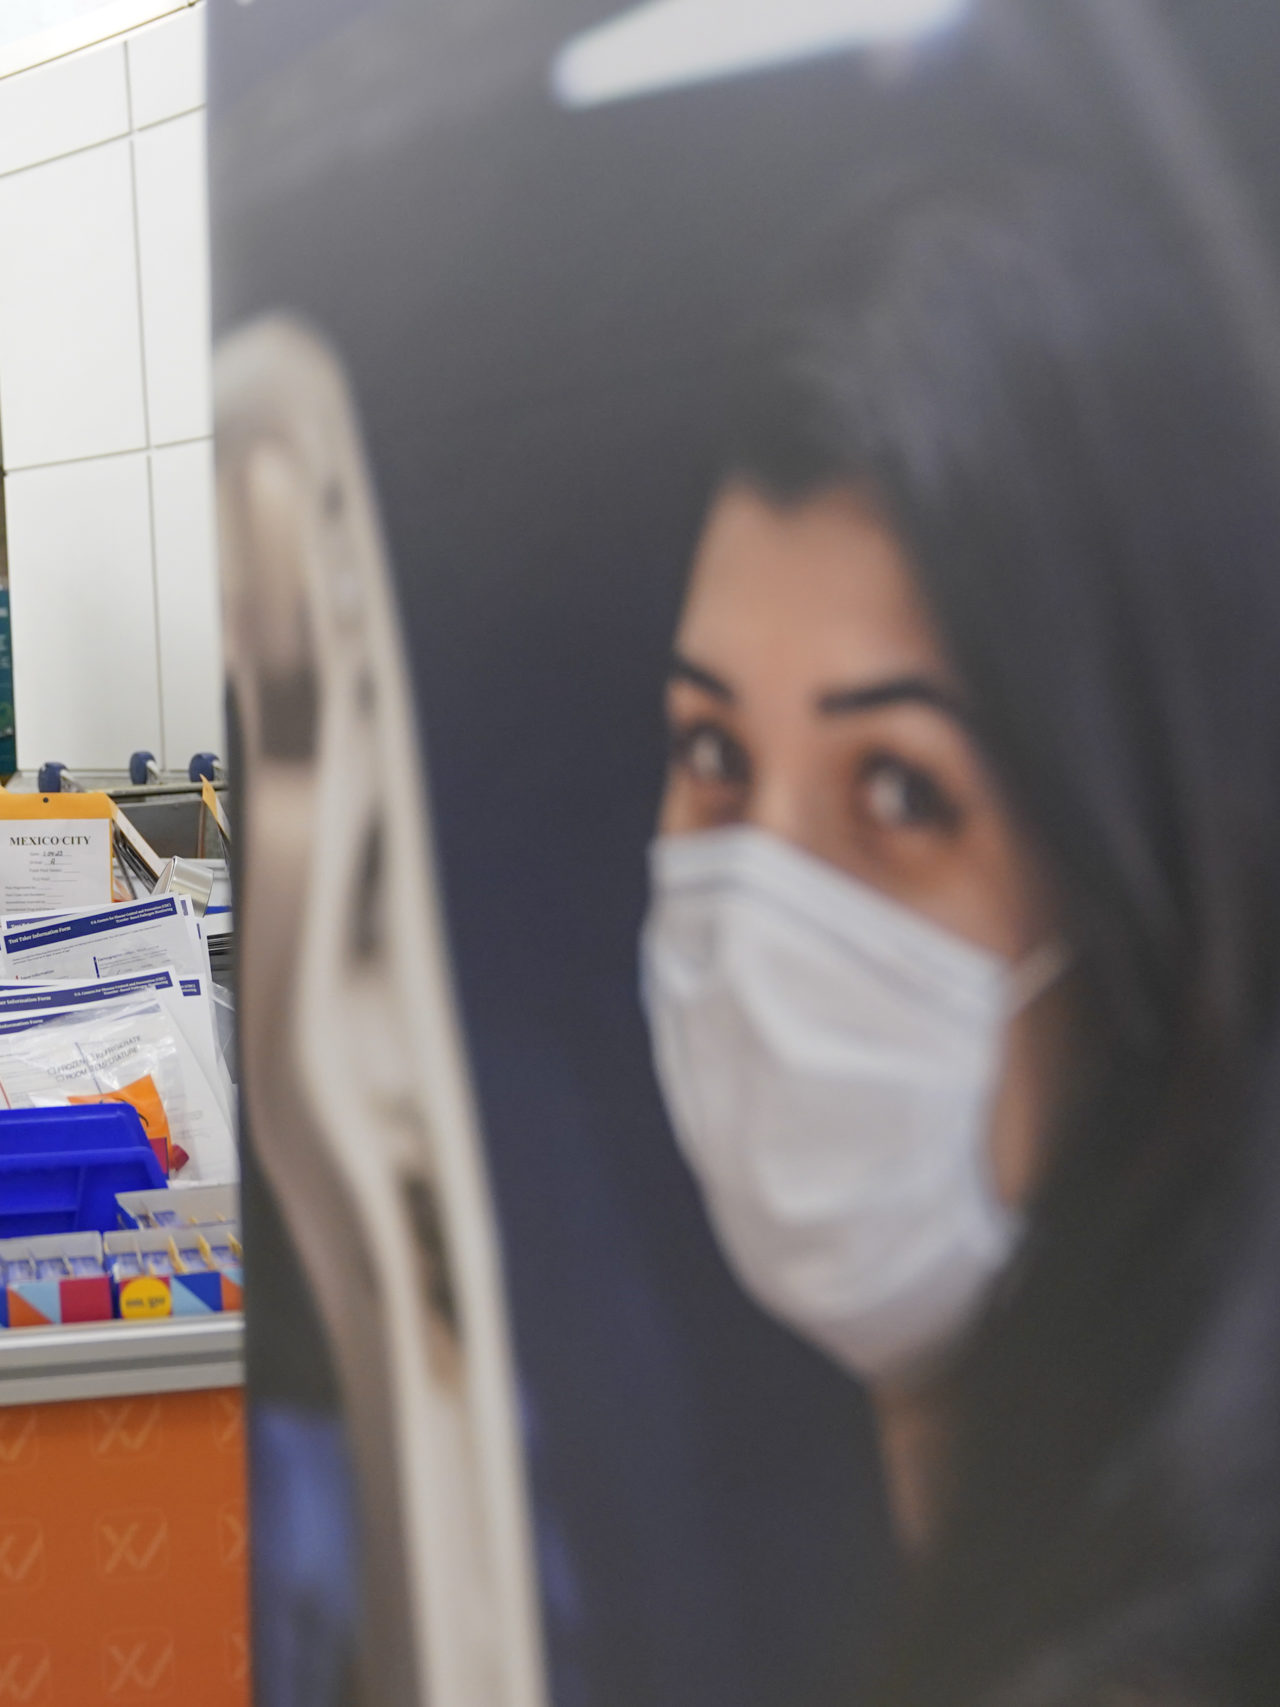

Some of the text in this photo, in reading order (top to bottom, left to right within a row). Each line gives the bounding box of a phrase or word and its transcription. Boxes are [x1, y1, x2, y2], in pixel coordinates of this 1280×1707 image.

[10, 835, 91, 846] MEXICO CITY
[32, 928, 59, 939] Information
[7, 996, 37, 1005] Information
[0, 1020, 29, 1029] Information
